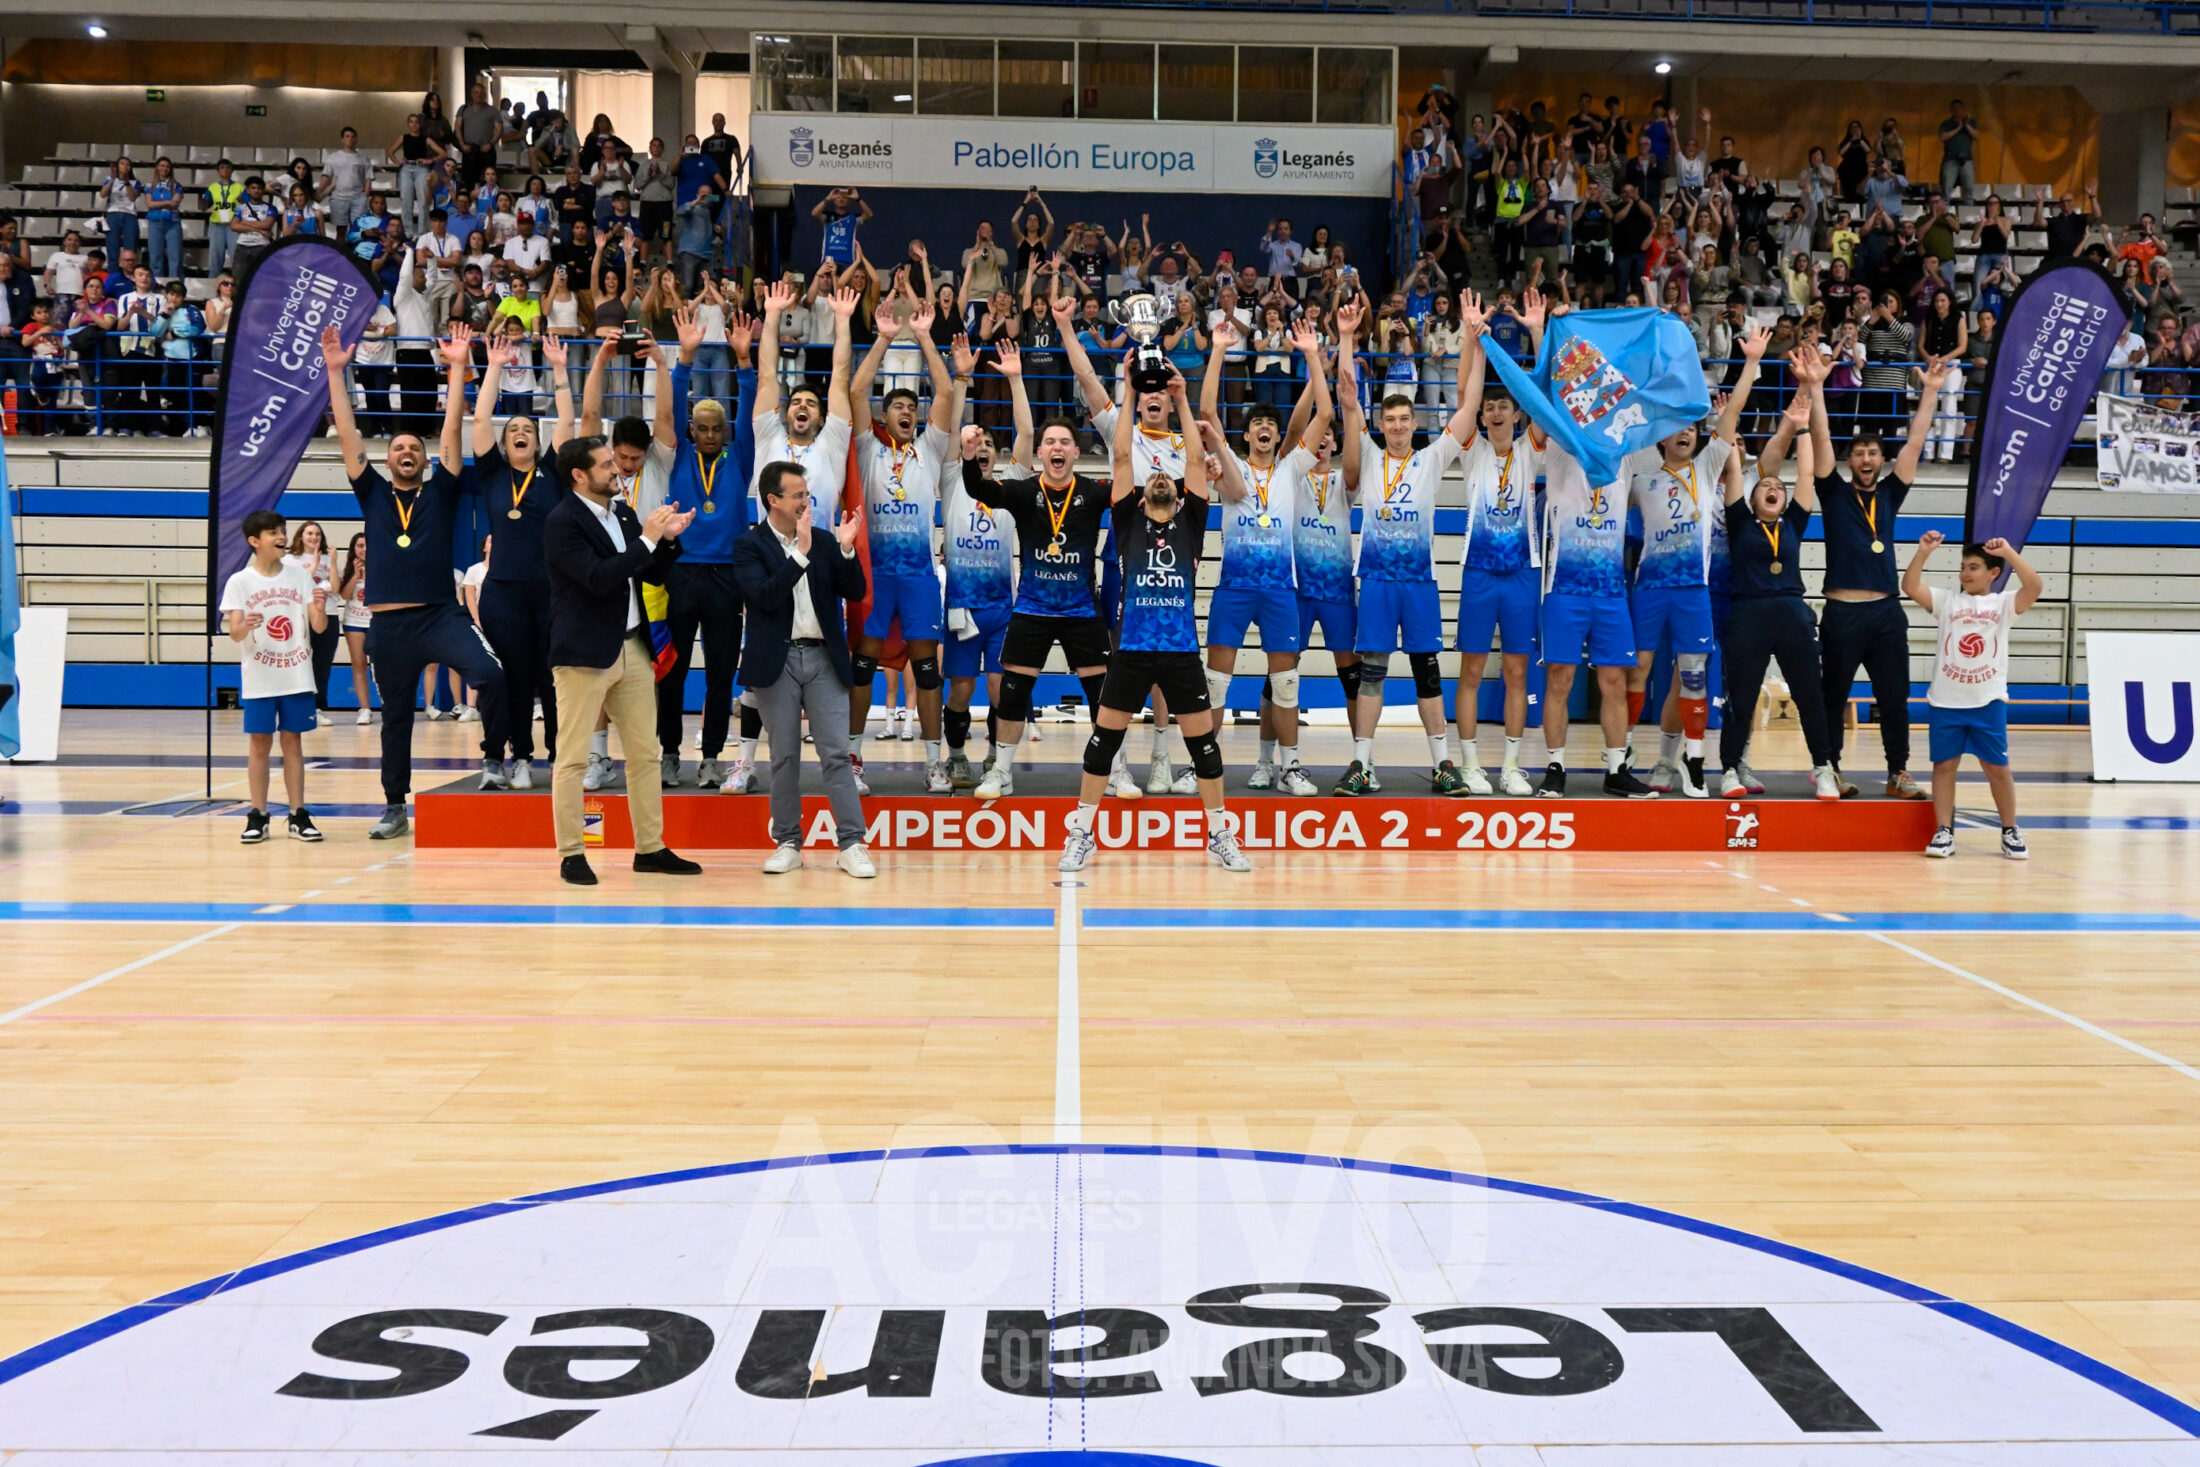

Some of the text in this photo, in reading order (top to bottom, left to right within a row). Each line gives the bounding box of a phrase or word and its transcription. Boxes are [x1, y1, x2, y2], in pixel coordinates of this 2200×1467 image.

[818, 139, 892, 159] Leganés
[954, 140, 1195, 176] Pabellón Europa
[1282, 150, 1355, 169] Leganés
[818, 159, 893, 170] AYUNTAMIENTO
[1282, 169, 1355, 181] AYUNTAMIENTO
[258, 265, 314, 362] Universidad
[280, 272, 339, 371] Carlos III
[2009, 291, 2068, 397] Universidad
[2025, 297, 2090, 404] Carlos III
[306, 355, 325, 381] de
[2049, 304, 2108, 412] de Madrid
[239, 394, 287, 457] uc3m
[2113, 448, 2192, 485] VAMOS
[873, 499, 919, 516] uc3m
[969, 511, 991, 533] 16
[1237, 514, 1282, 529] ucm
[956, 534, 1000, 551] uc3m
[1034, 569, 1079, 582] LEGANÉS
[1136, 570, 1185, 589] uc3m
[1135, 595, 1185, 608] LEGANÉS
[1942, 663, 1998, 684] SUPERLIGA
[768, 800, 1046, 848] AMPEÓN
[1063, 810, 1366, 848] UPELIGA
[1379, 810, 1409, 848] 2
[1456, 812, 1576, 849] 2025
[1727, 838, 1758, 848] SM-2
[274, 1281, 1883, 1441] Leganés
